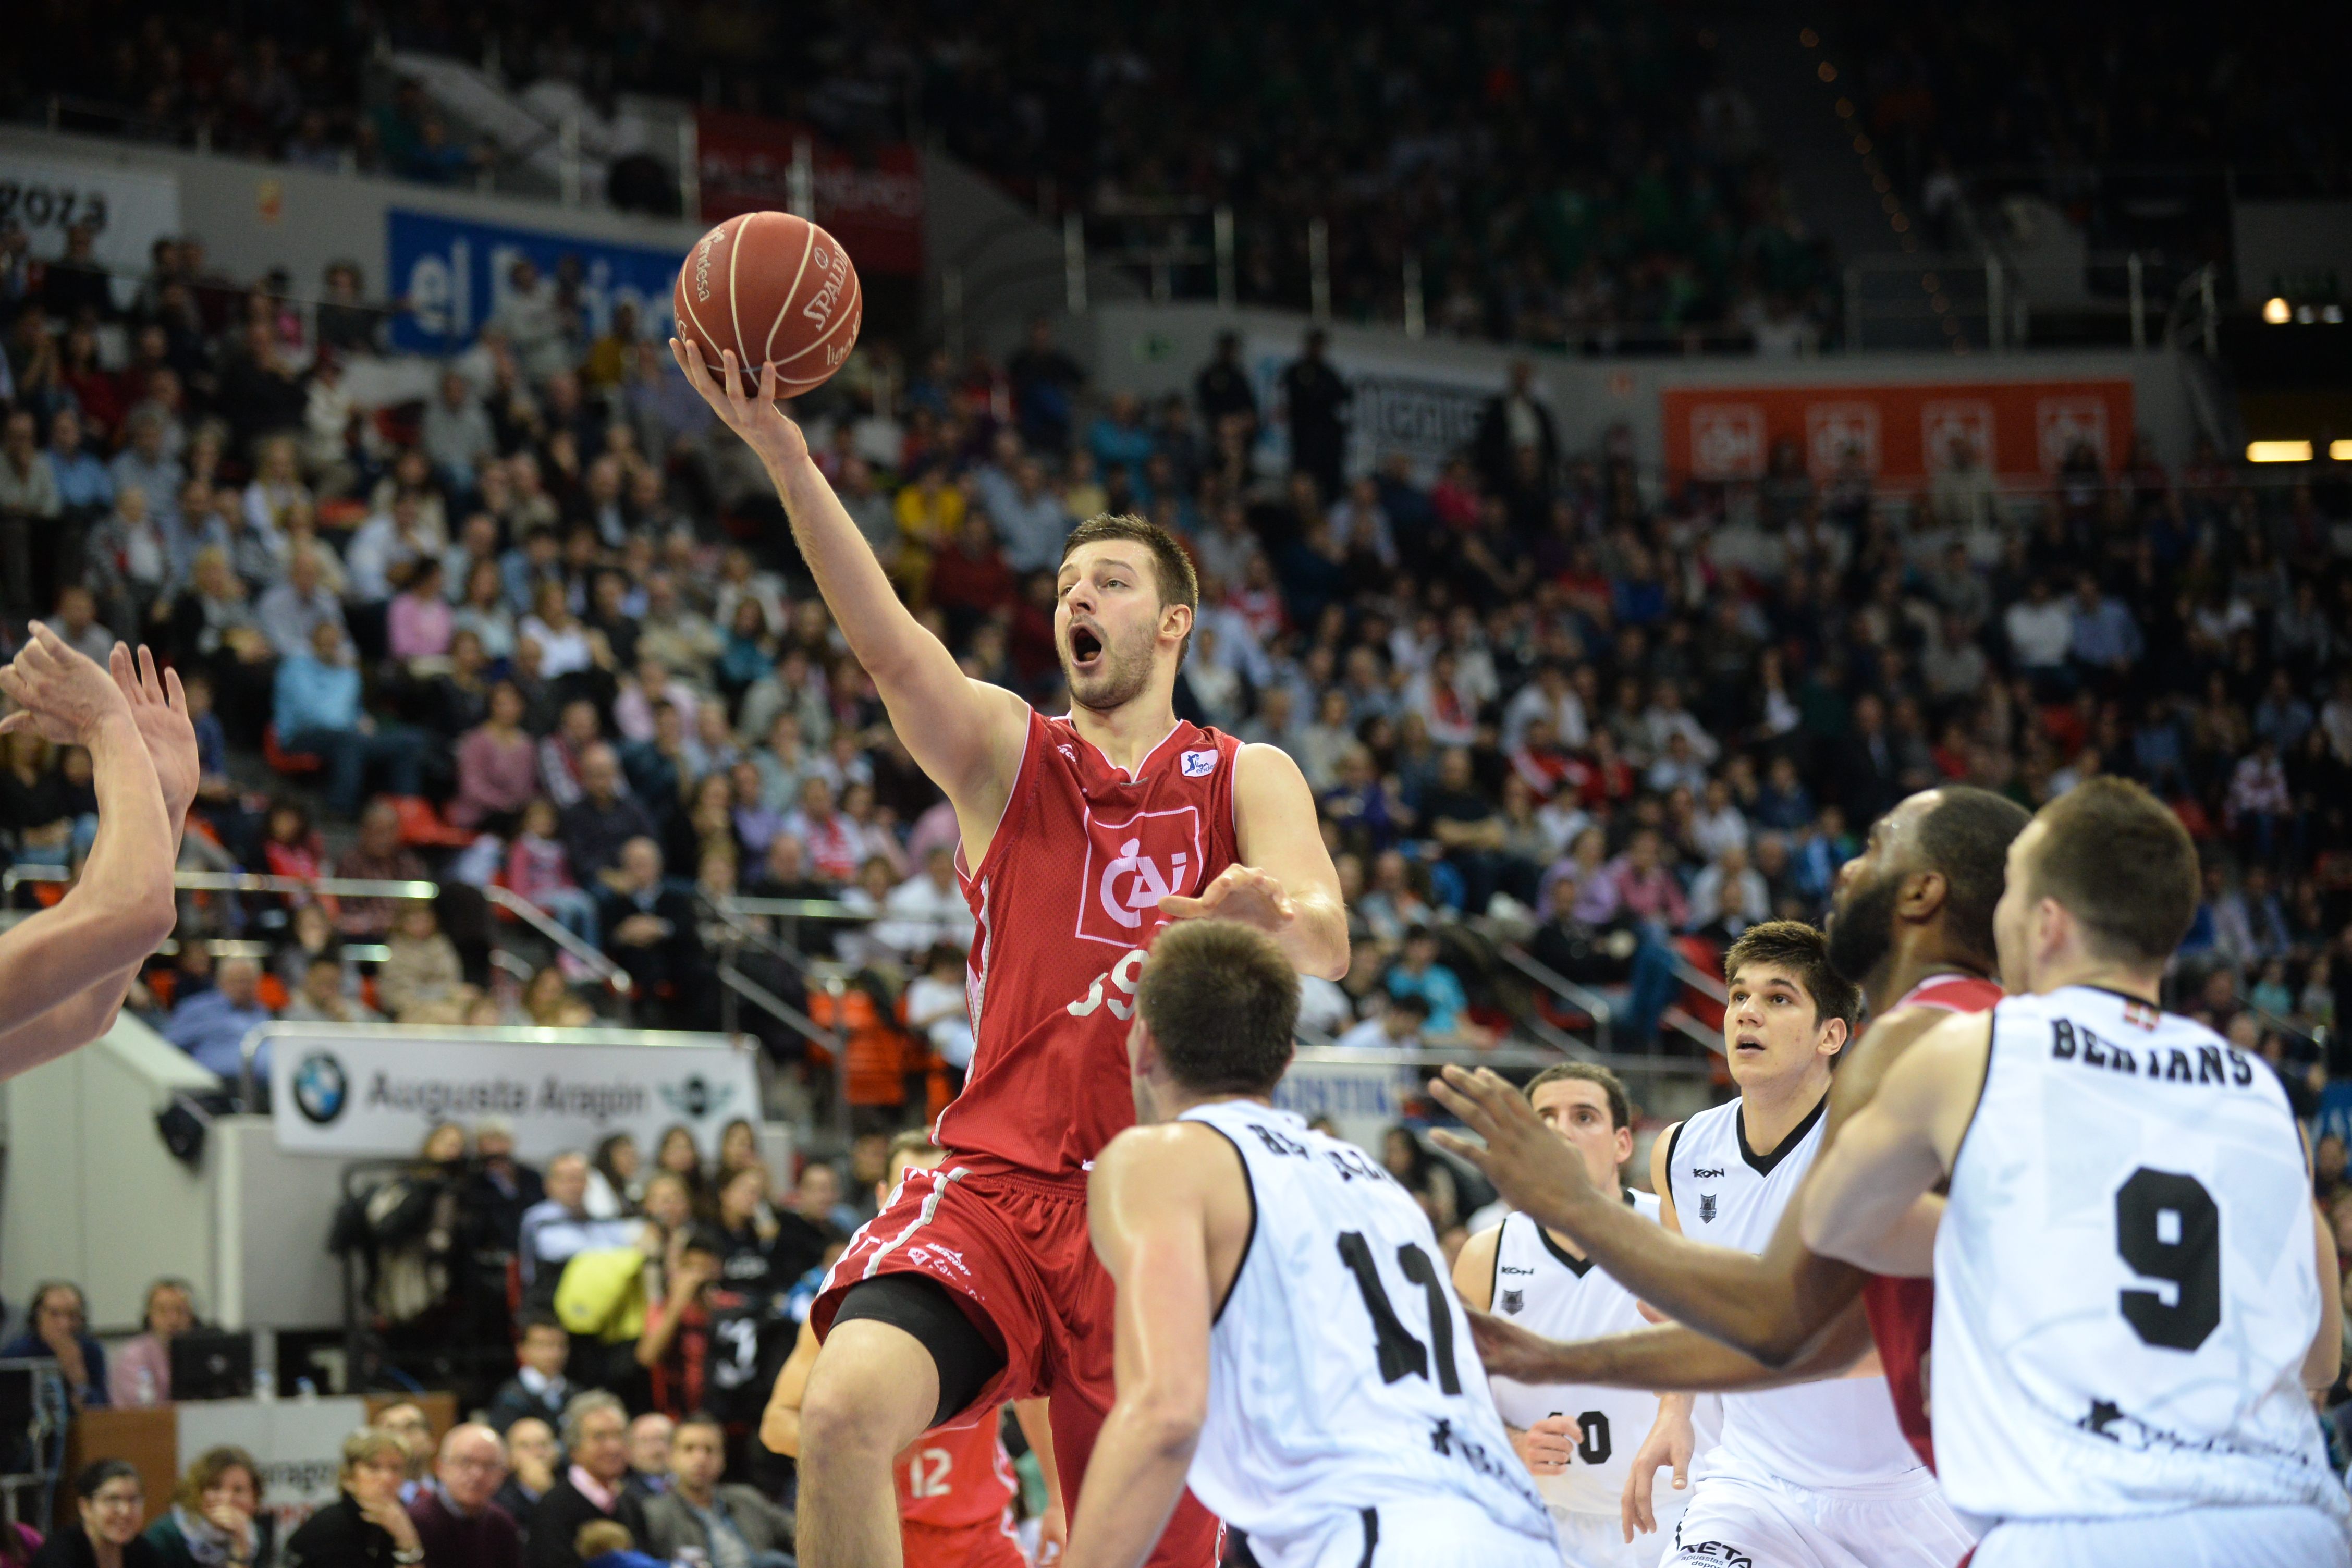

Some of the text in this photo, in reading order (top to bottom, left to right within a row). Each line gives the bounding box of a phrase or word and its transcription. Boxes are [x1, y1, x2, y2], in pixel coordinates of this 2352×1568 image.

[409, 237, 469, 335] el
[803, 238, 848, 332] SPALDI
[2116, 1166, 2221, 1353] 9
[909, 1448, 953, 1498] 12
[1549, 1411, 1612, 1465] 0
[1681, 1555, 1724, 1566] apuestas
